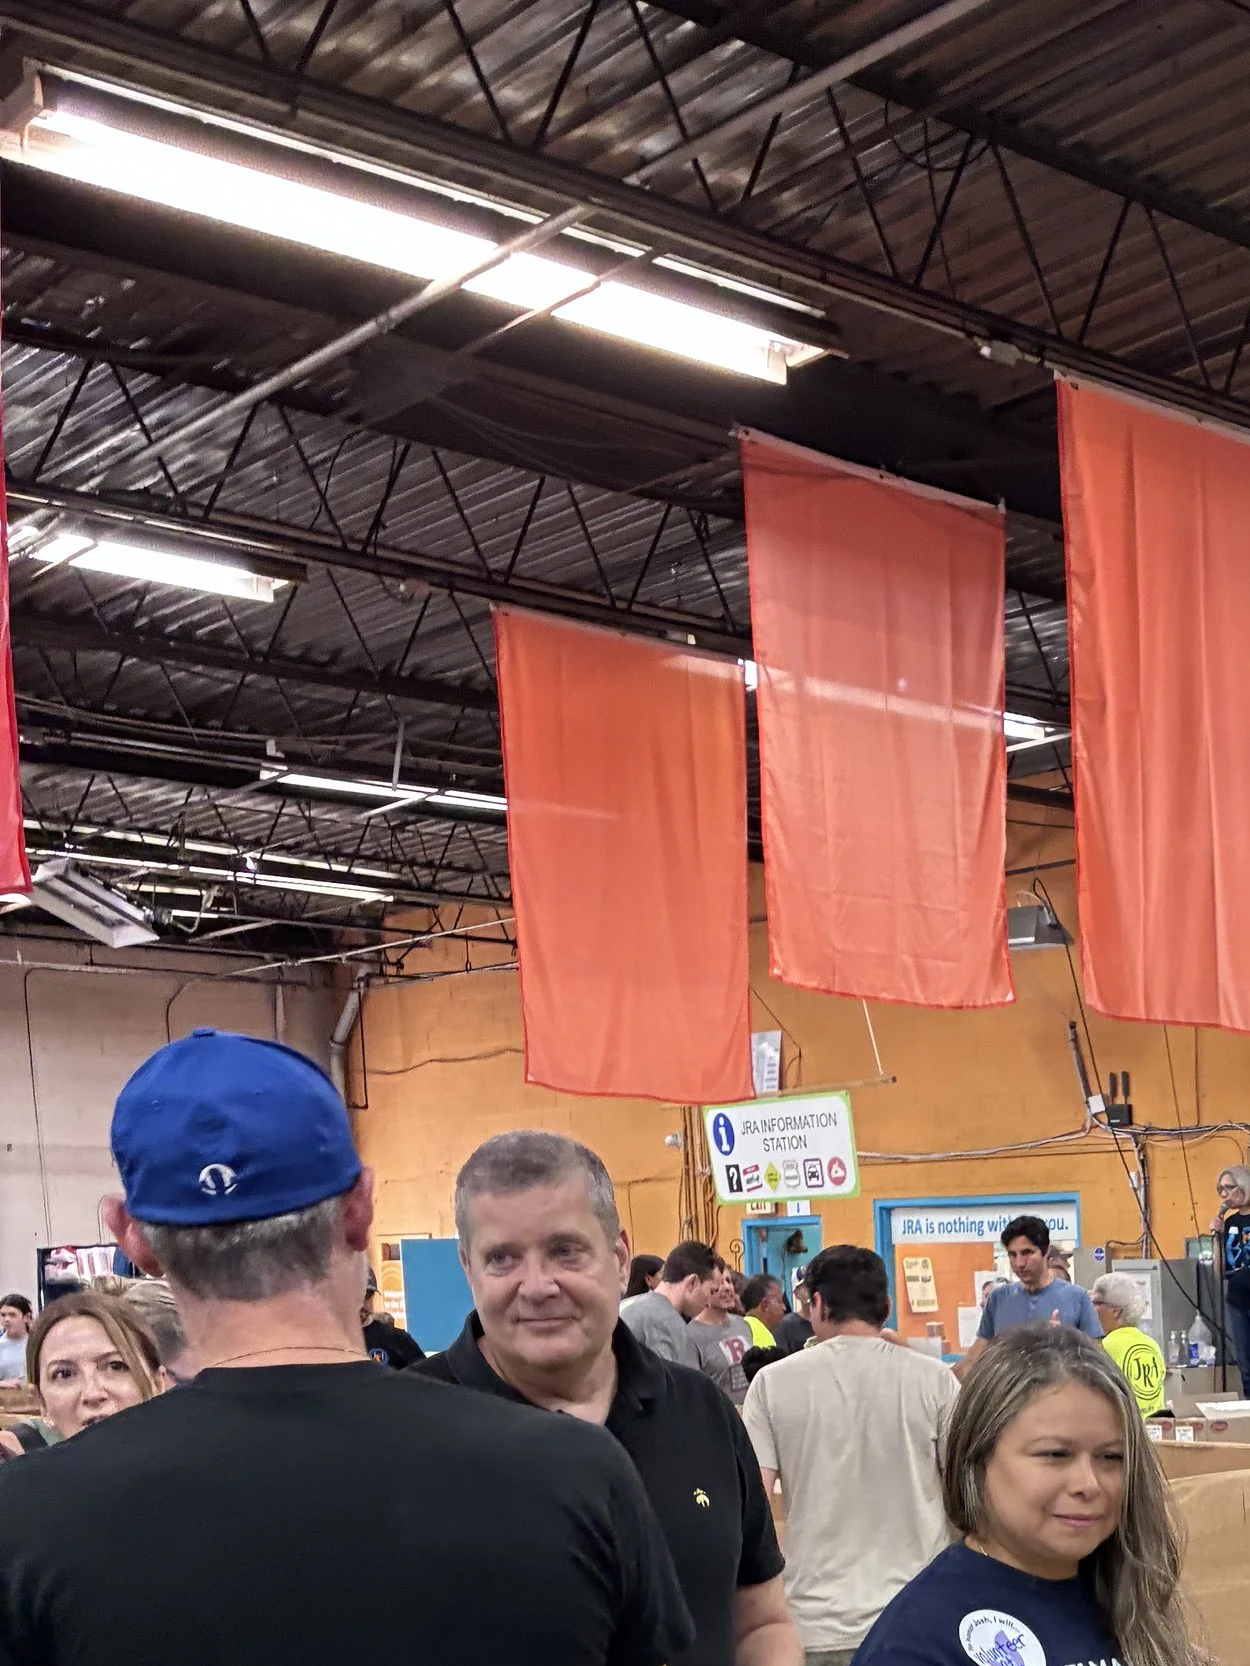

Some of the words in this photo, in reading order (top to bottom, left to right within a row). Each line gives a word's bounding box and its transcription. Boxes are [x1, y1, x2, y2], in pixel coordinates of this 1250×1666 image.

[741, 1120, 760, 1136] JRA
[760, 1112, 838, 1134] INFORMATION
[762, 1135, 808, 1152] STATION
[902, 1219, 922, 1235] JRA
[925, 1218, 935, 1234] is
[938, 1216, 985, 1236] nothing
[1133, 1356, 1159, 1388] JRA
